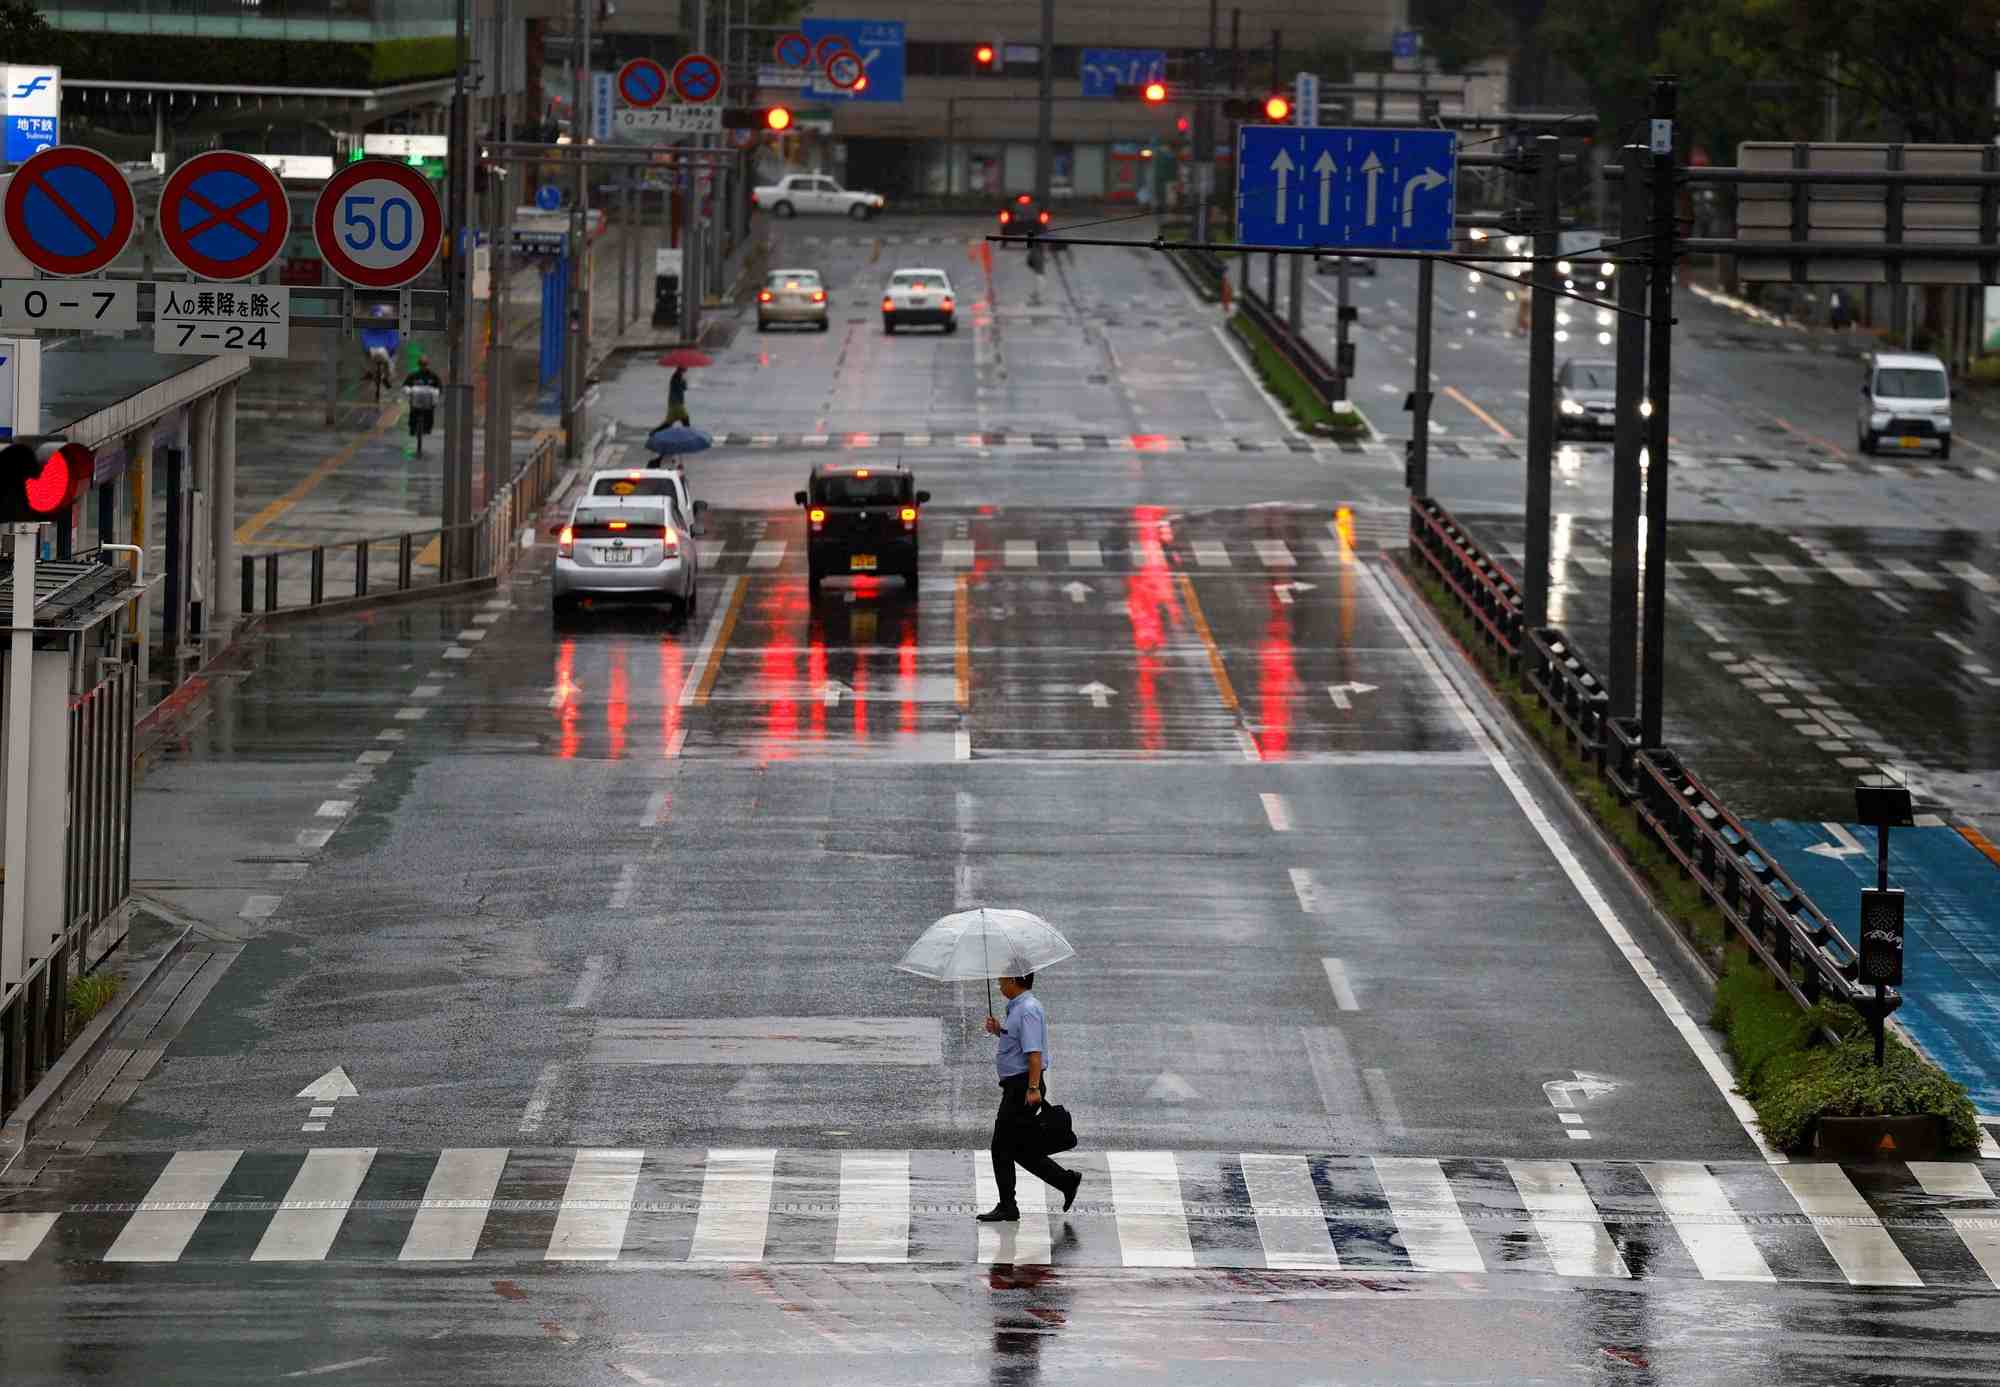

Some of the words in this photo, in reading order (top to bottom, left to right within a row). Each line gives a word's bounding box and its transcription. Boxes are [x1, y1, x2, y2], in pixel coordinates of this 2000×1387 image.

[344, 196, 413, 251] 50
[163, 291, 281, 318] 人の乗降を除く
[176, 324, 267, 350] 7-24
